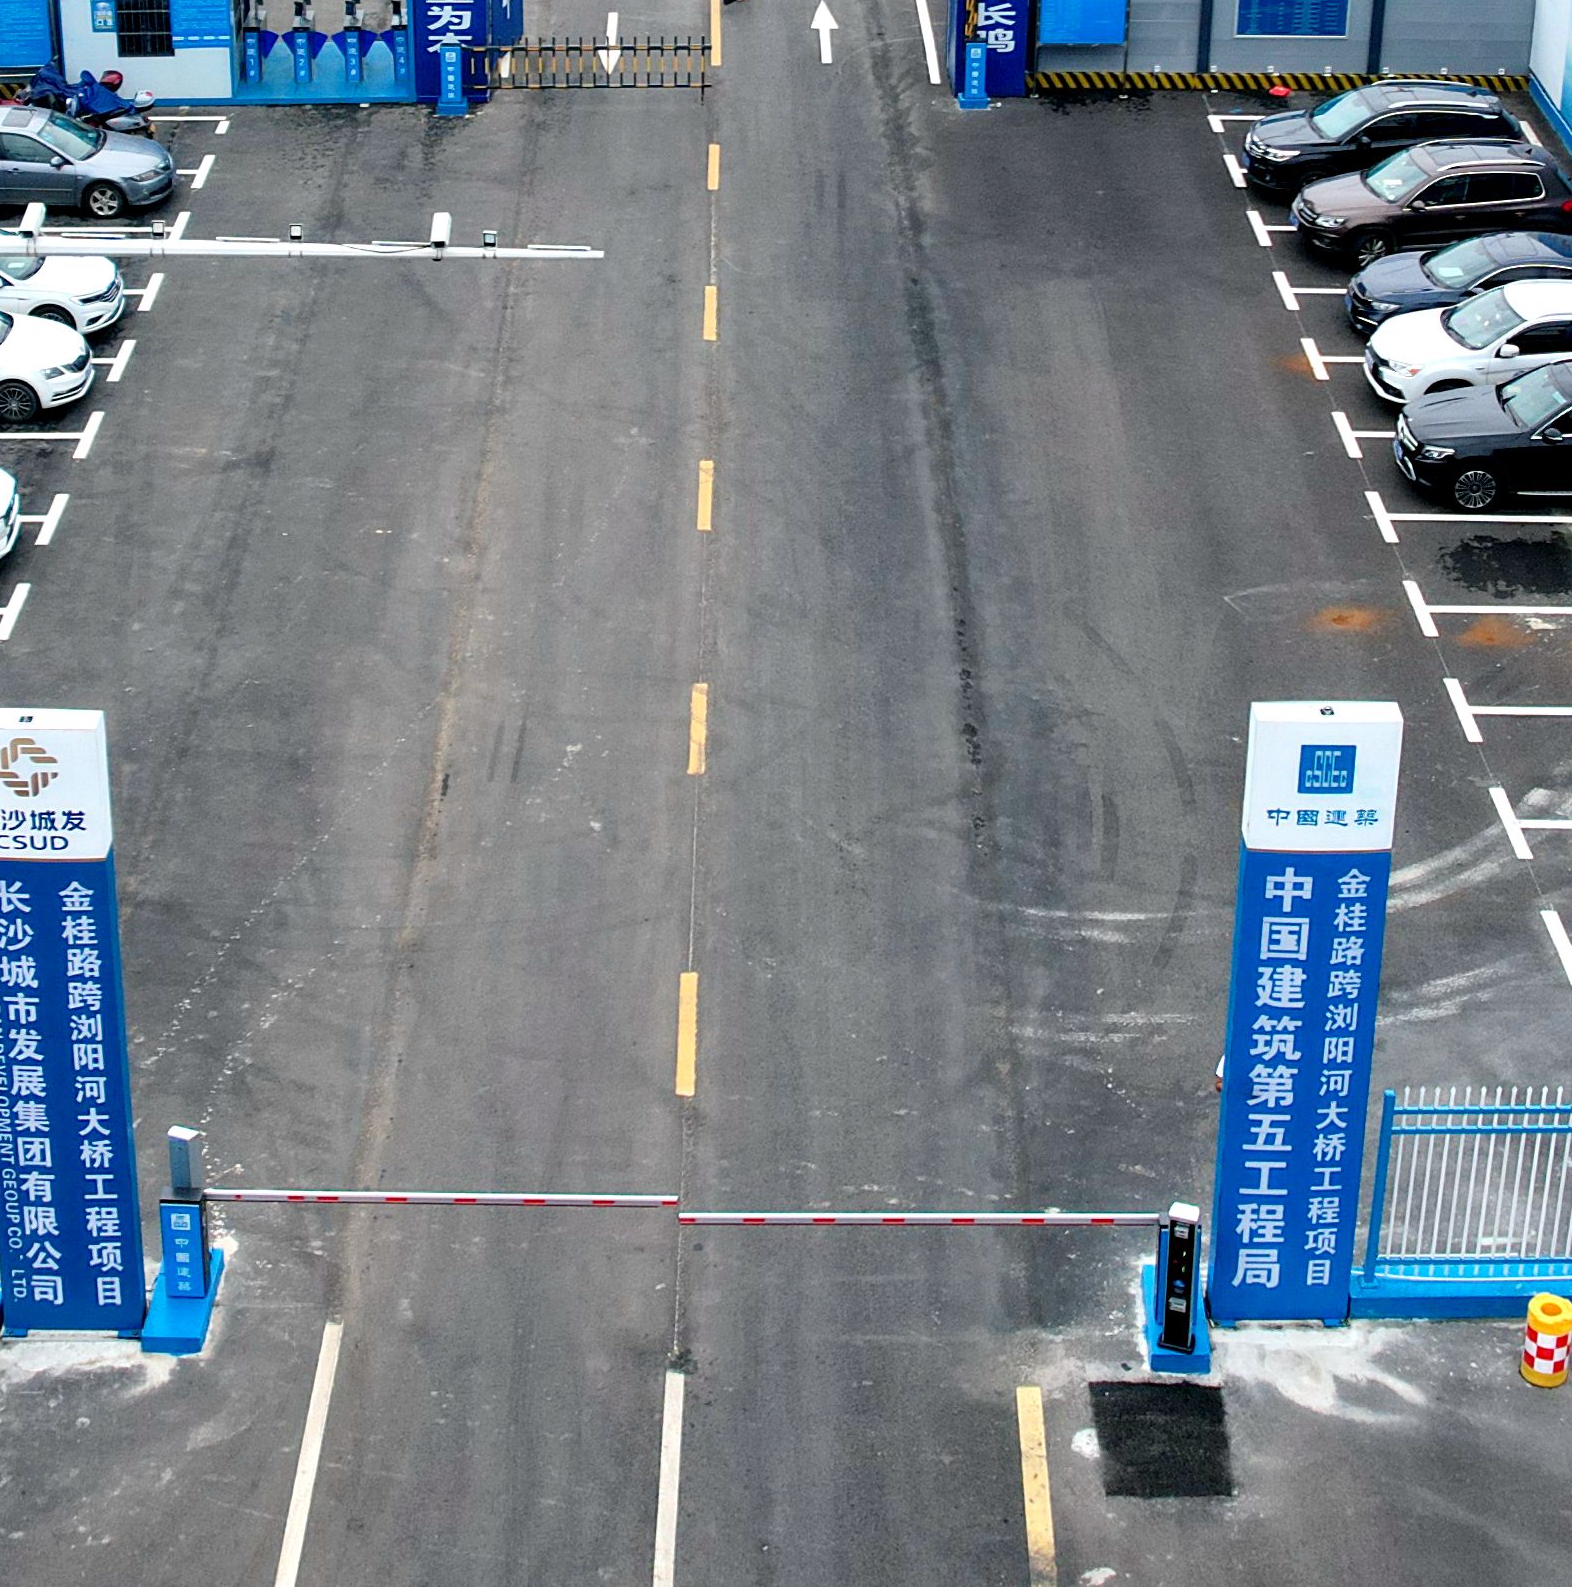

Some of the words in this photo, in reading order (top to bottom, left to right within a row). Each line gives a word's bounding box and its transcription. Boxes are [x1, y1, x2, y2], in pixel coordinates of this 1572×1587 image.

[58, 881, 123, 1307] 金桂路跨浏阳河大桥工程项目
[1232, 867, 1315, 1290] 中国建筑第五工程局
[1305, 868, 1372, 1287] 金桂路跨浏阳河大桥工程项目
